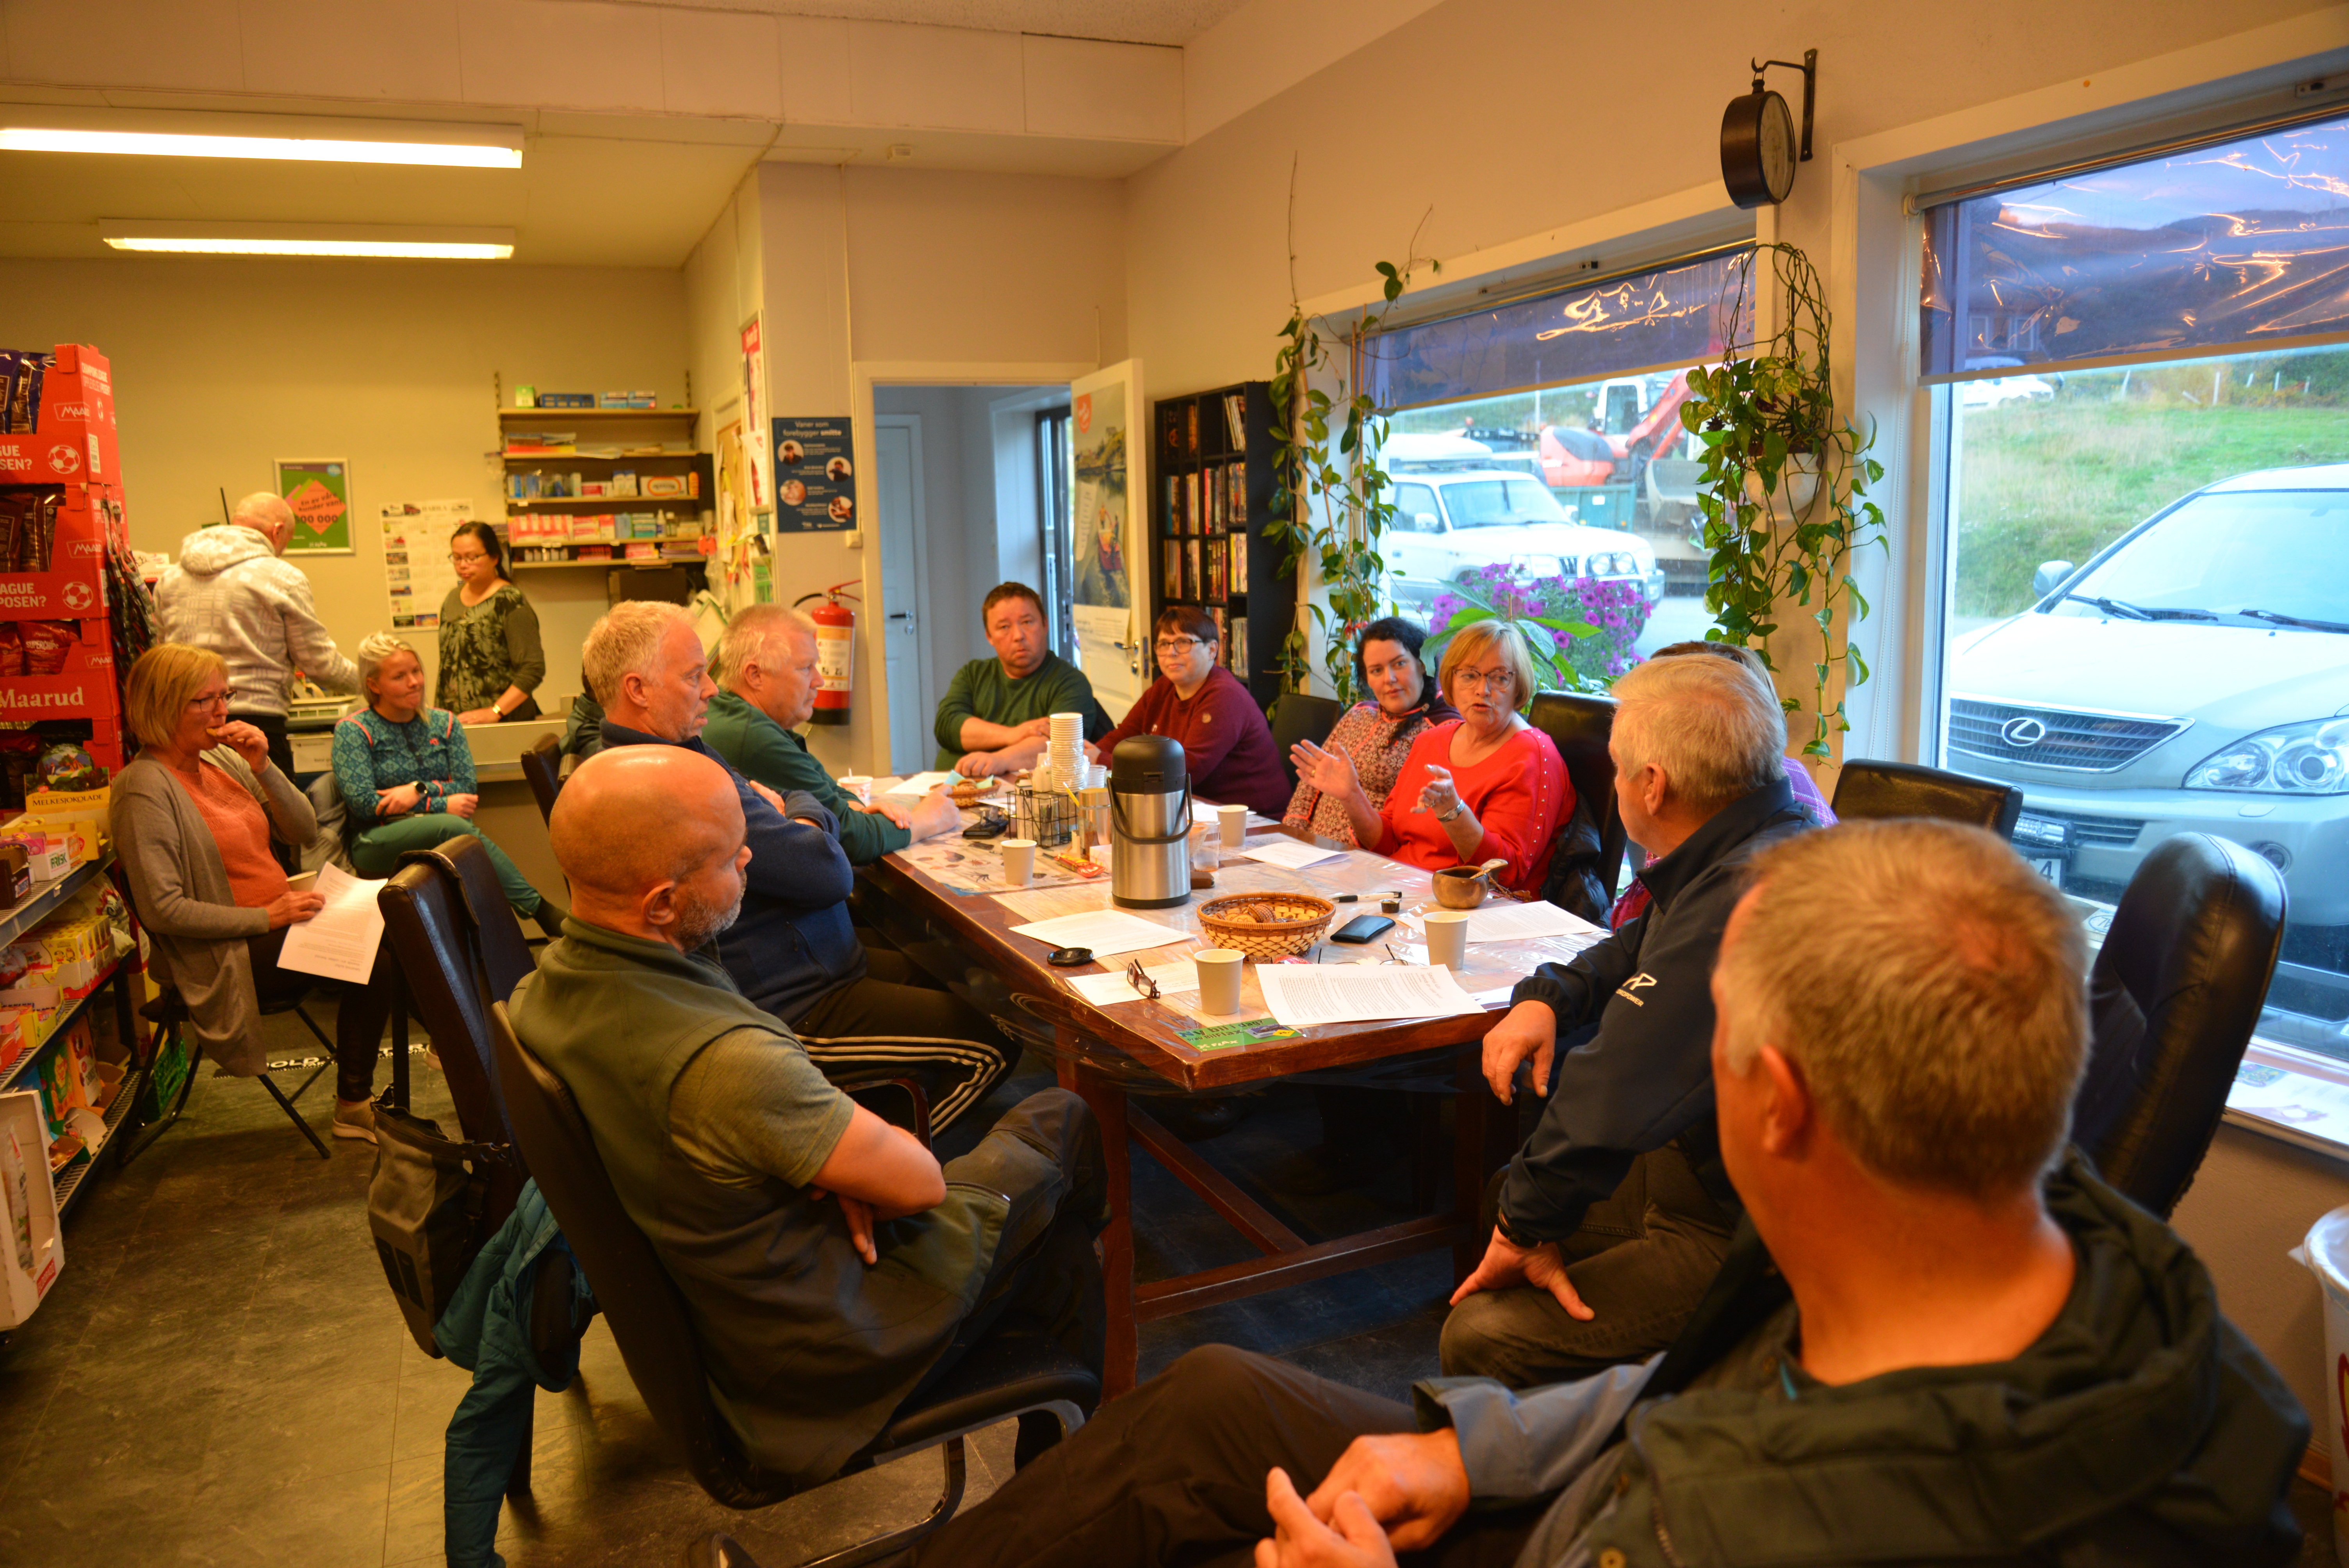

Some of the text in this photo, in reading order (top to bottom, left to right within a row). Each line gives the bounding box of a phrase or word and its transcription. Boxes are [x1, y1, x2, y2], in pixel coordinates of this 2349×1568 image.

[0, 686, 85, 708] Maarud
[33, 794, 103, 807] MELKESJOKOLADE
[50, 852, 67, 869] FRISK
[1207, 1023, 1229, 1033] bil
[1238, 1019, 1264, 1028] dag?
[267, 1057, 319, 1068] OLD
